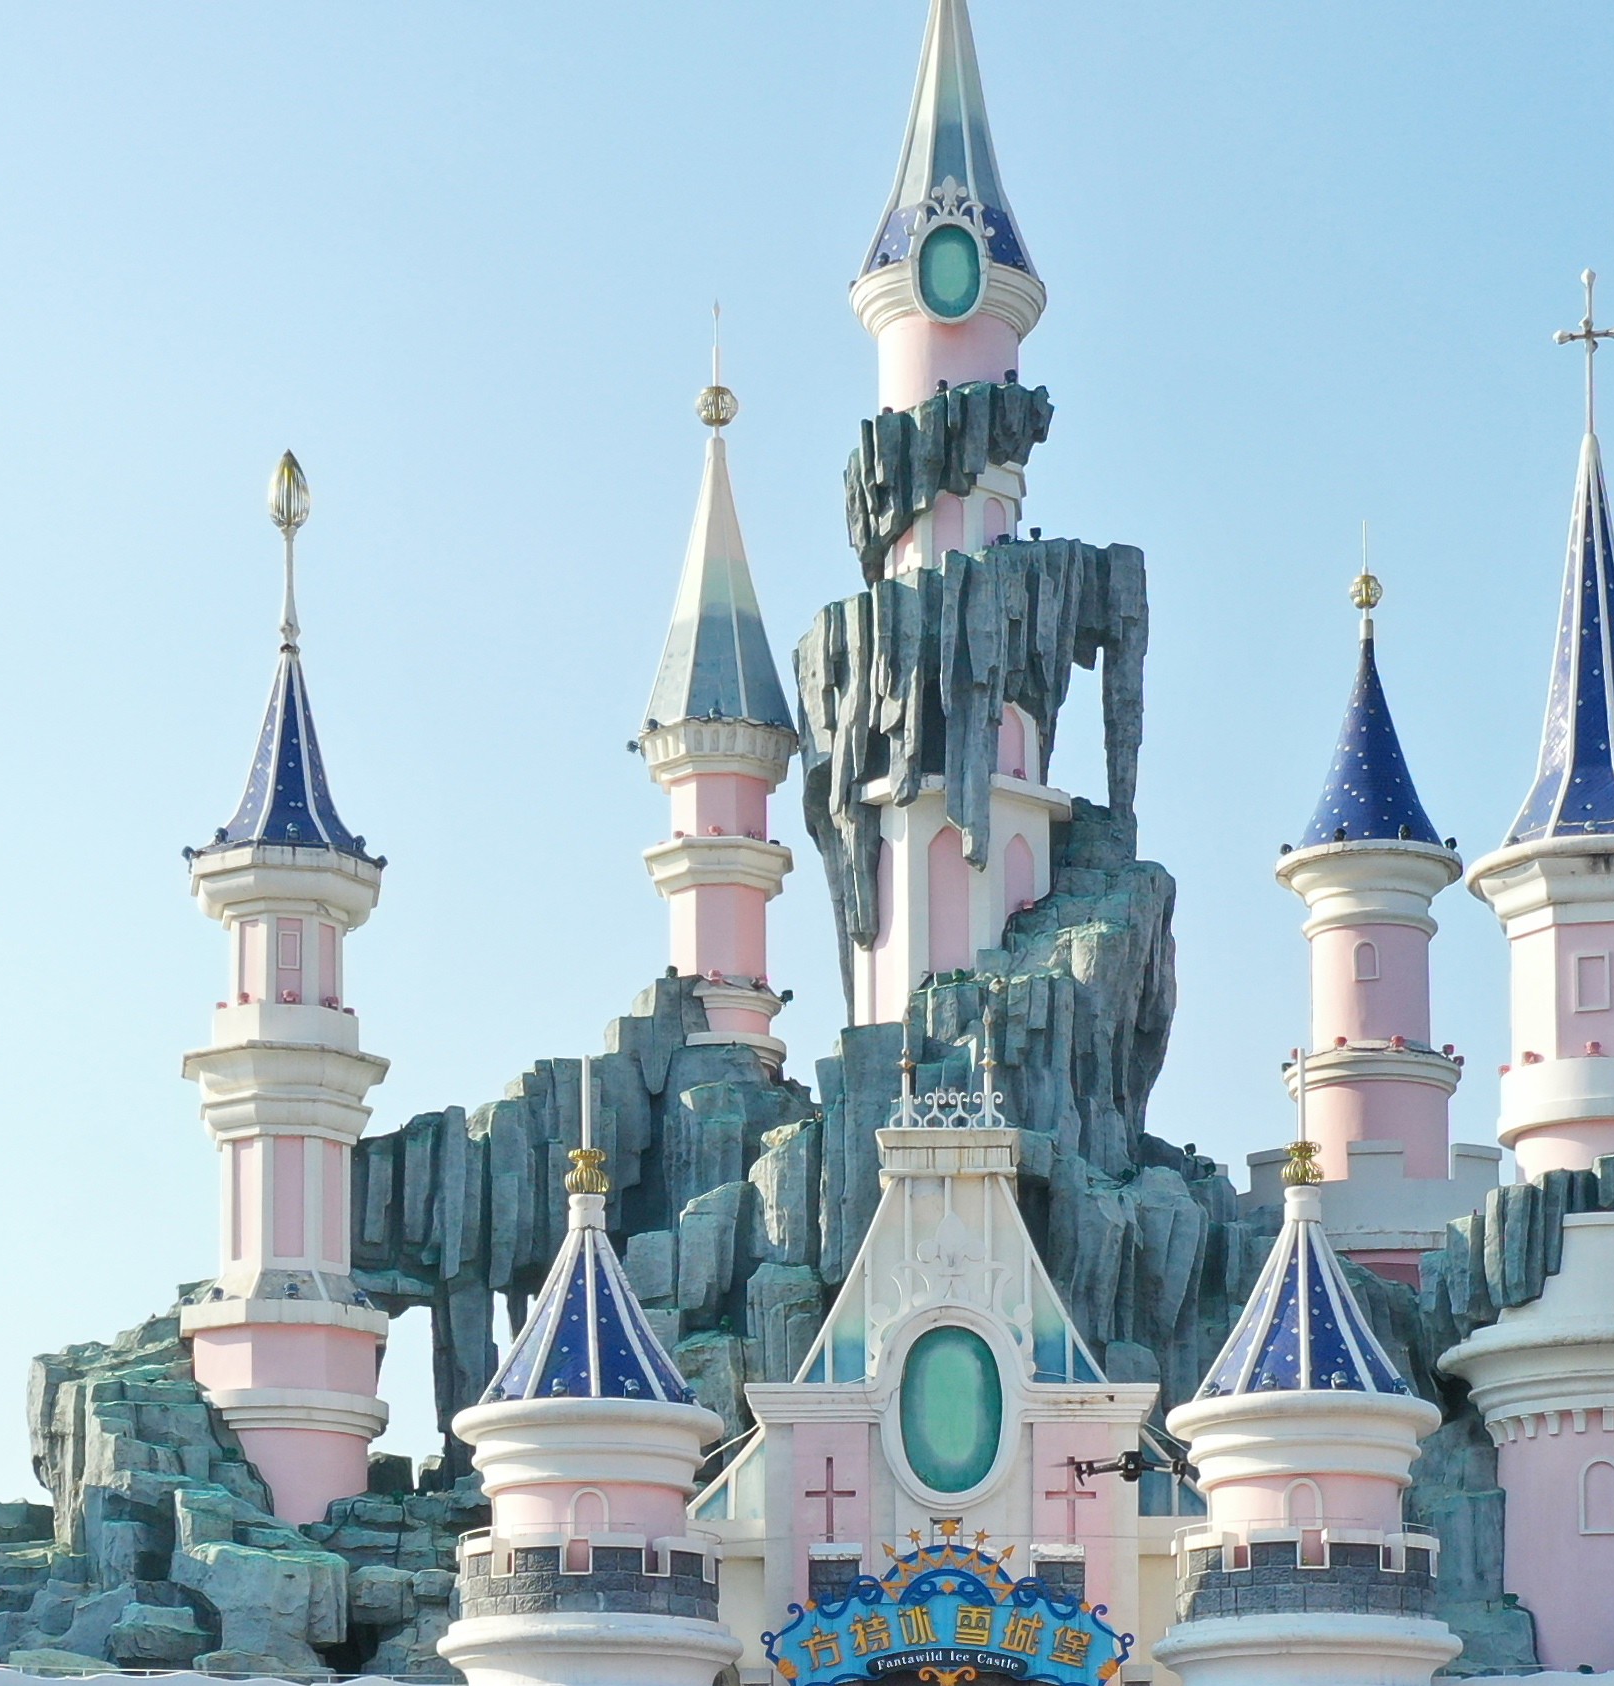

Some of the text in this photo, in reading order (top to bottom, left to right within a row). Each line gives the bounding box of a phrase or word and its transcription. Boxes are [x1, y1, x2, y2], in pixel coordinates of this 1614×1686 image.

[798, 1603, 1093, 1672] 方特冰雪城堡
[876, 1650, 1019, 1671] Fantawild Ice Castle
